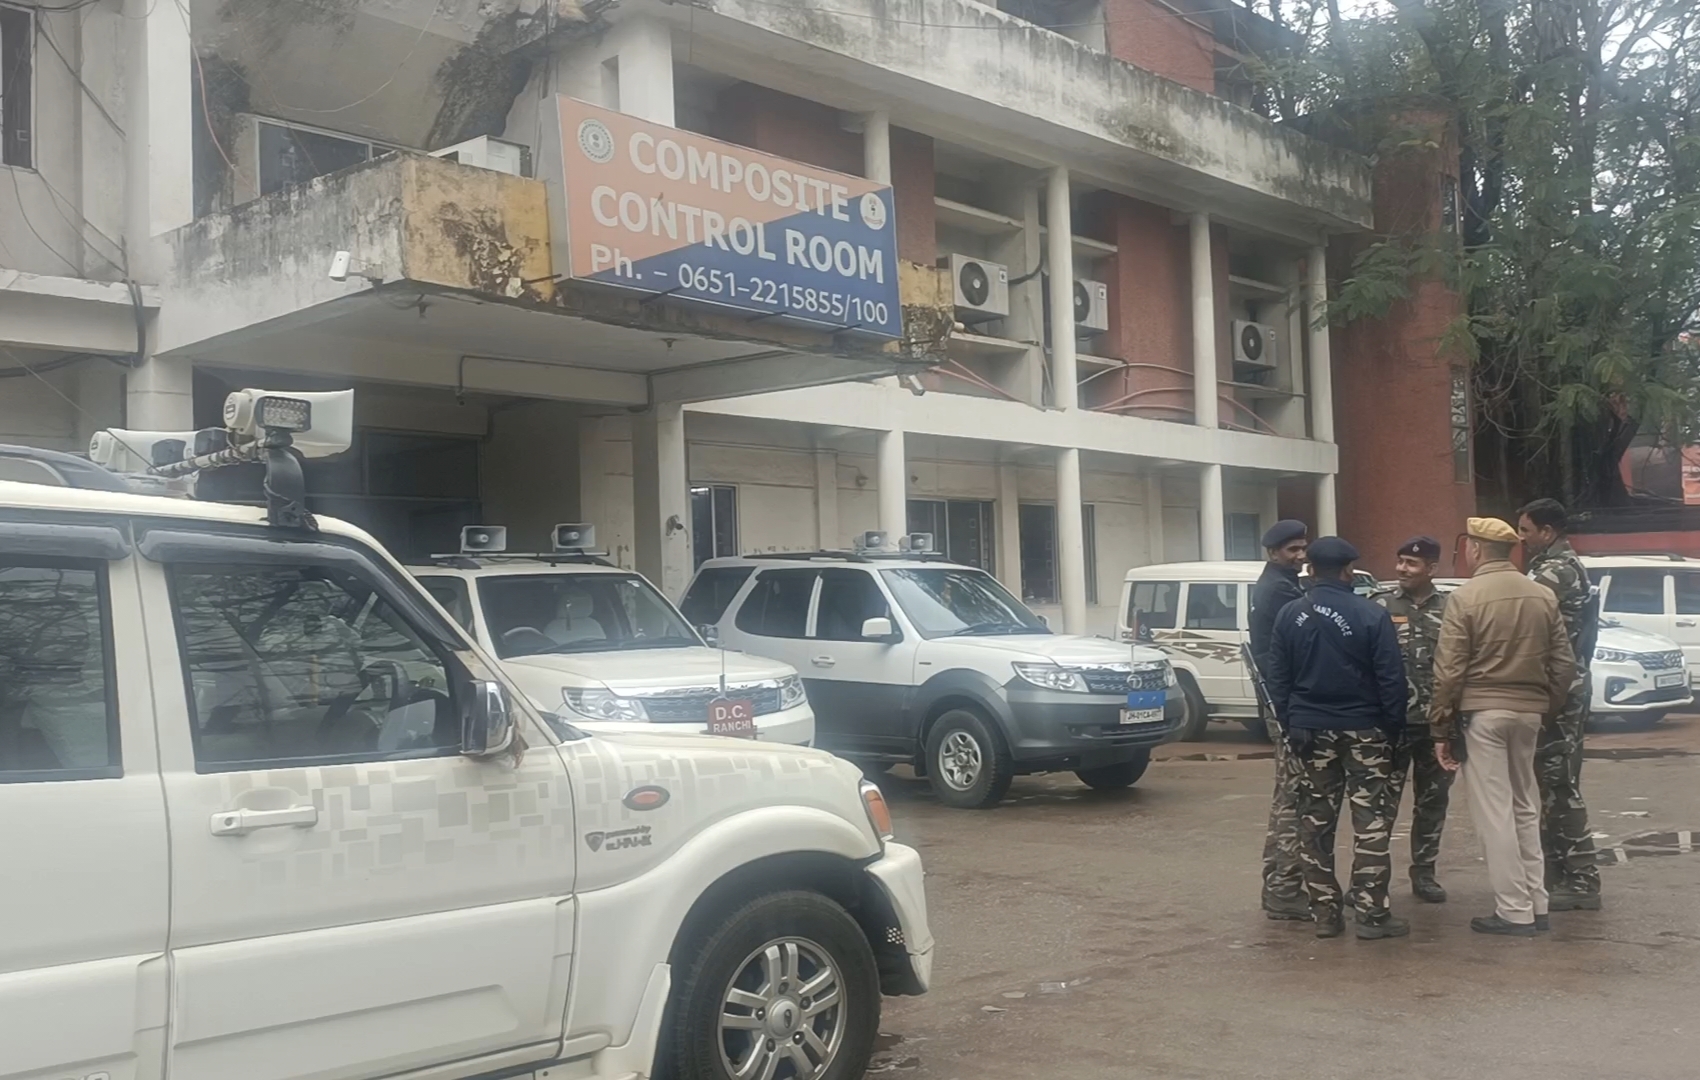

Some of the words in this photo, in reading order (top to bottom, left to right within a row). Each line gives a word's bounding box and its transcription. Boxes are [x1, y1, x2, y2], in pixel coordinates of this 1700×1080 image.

[629, 132, 850, 222] COMPOSITE
[591, 185, 776, 261] CONTROL
[785, 228, 884, 284] ROOM
[591, 243, 642, 280] Ph.
[678, 263, 888, 326] 0651-2215855/100
[1330, 611, 1353, 637] POLICE
[713, 719, 751, 733] RANCHI
[715, 704, 747, 721] D.C.
